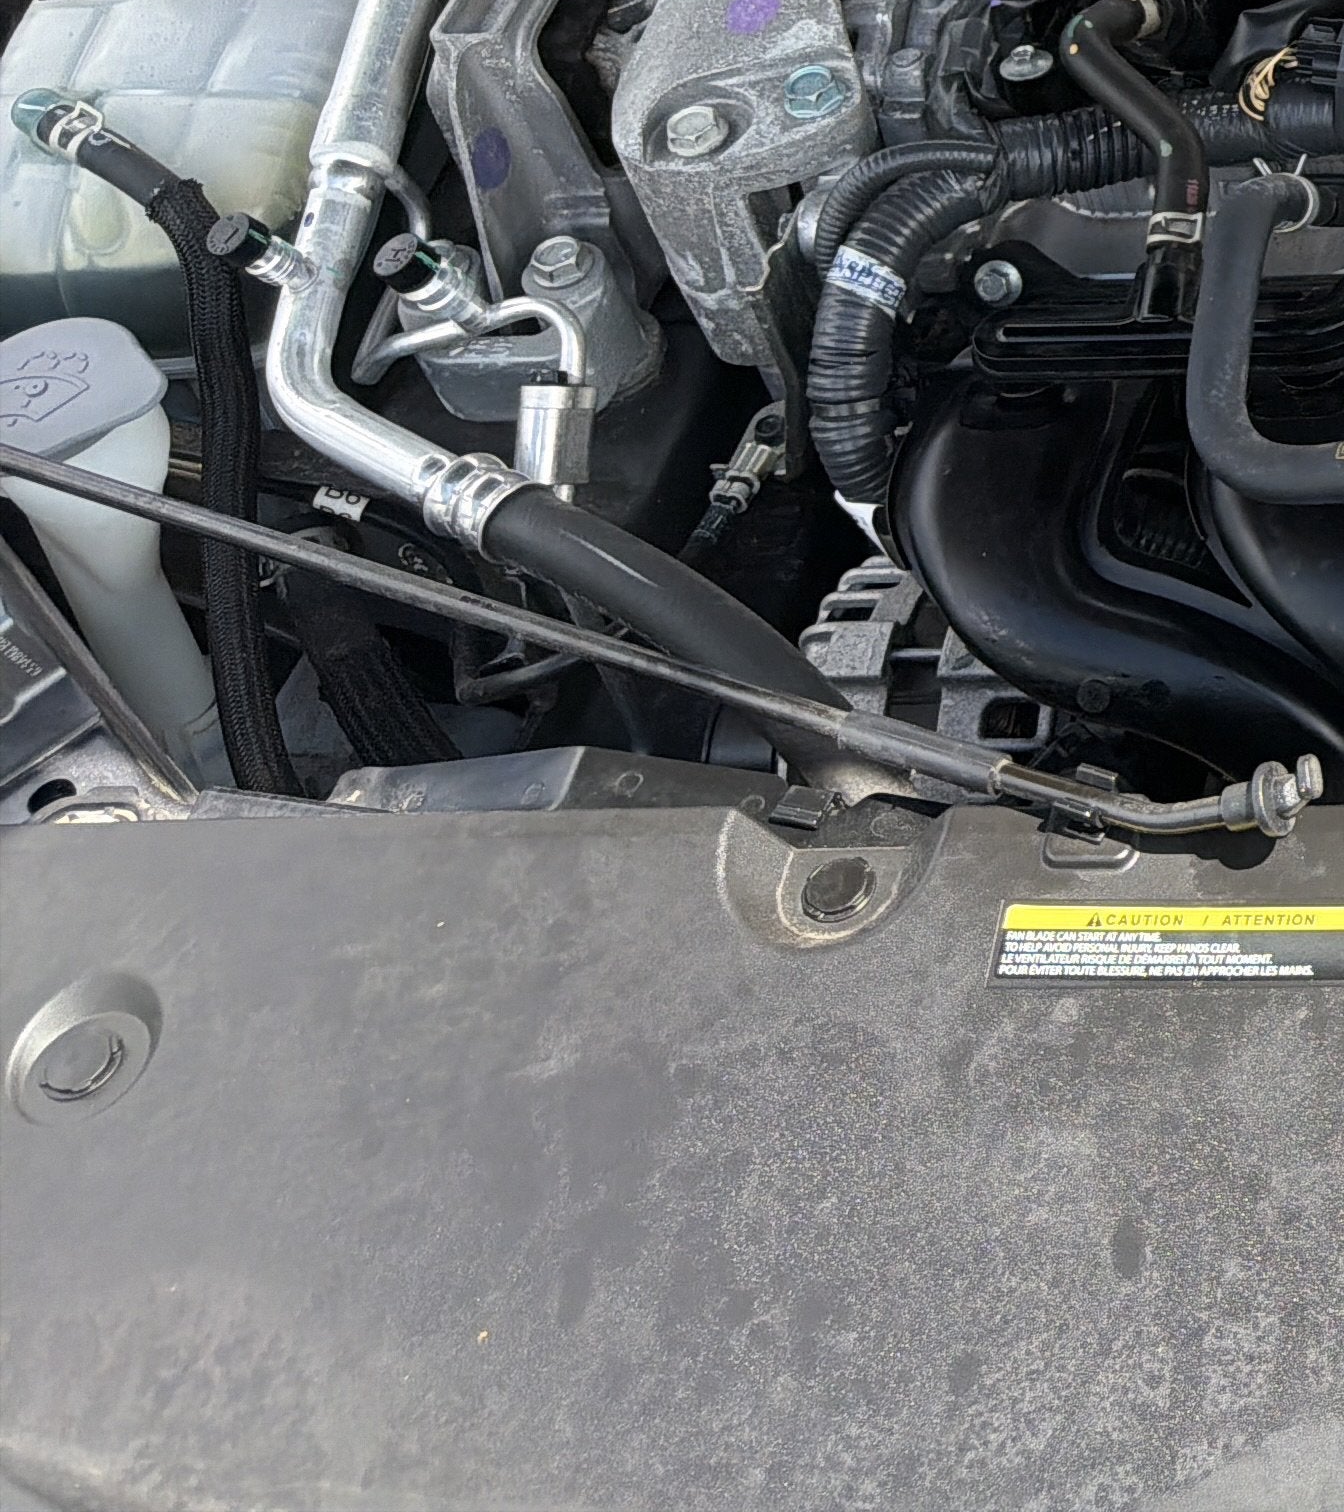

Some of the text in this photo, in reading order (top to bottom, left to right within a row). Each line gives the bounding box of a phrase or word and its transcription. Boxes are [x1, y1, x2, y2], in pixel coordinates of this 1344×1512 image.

[1106, 914, 1184, 926] CAUTION
[1222, 913, 1315, 926] ATTENTION
[1006, 931, 1025, 942] FAN
[1026, 931, 1055, 942] BLADE
[1056, 931, 1076, 942] CAN
[1077, 931, 1104, 942] START
[1105, 931, 1117, 942] AT
[1118, 931, 1138, 942] ANY
[1005, 942, 1017, 953] TO
[1018, 942, 1041, 953] HELP
[1042, 942, 1071, 953] AVOID
[1073, 942, 1117, 953] PERSONAL
[1177, 942, 1209, 953] HANDS
[1001, 953, 1013, 965] LE
[1014, 953, 1080, 965] VENTILATEUR
[1081, 953, 1116, 965] RISQUE
[1118, 953, 1132, 965] DE
[1198, 953, 1225, 965] TOUT
[999, 964, 1027, 977] POUR
[1063, 964, 1095, 977] TOUTE
[1149, 964, 1163, 977] NE
[1164, 964, 1183, 977] PAS
[1184, 964, 1199, 977] EN
[1261, 964, 1278, 977] LES
